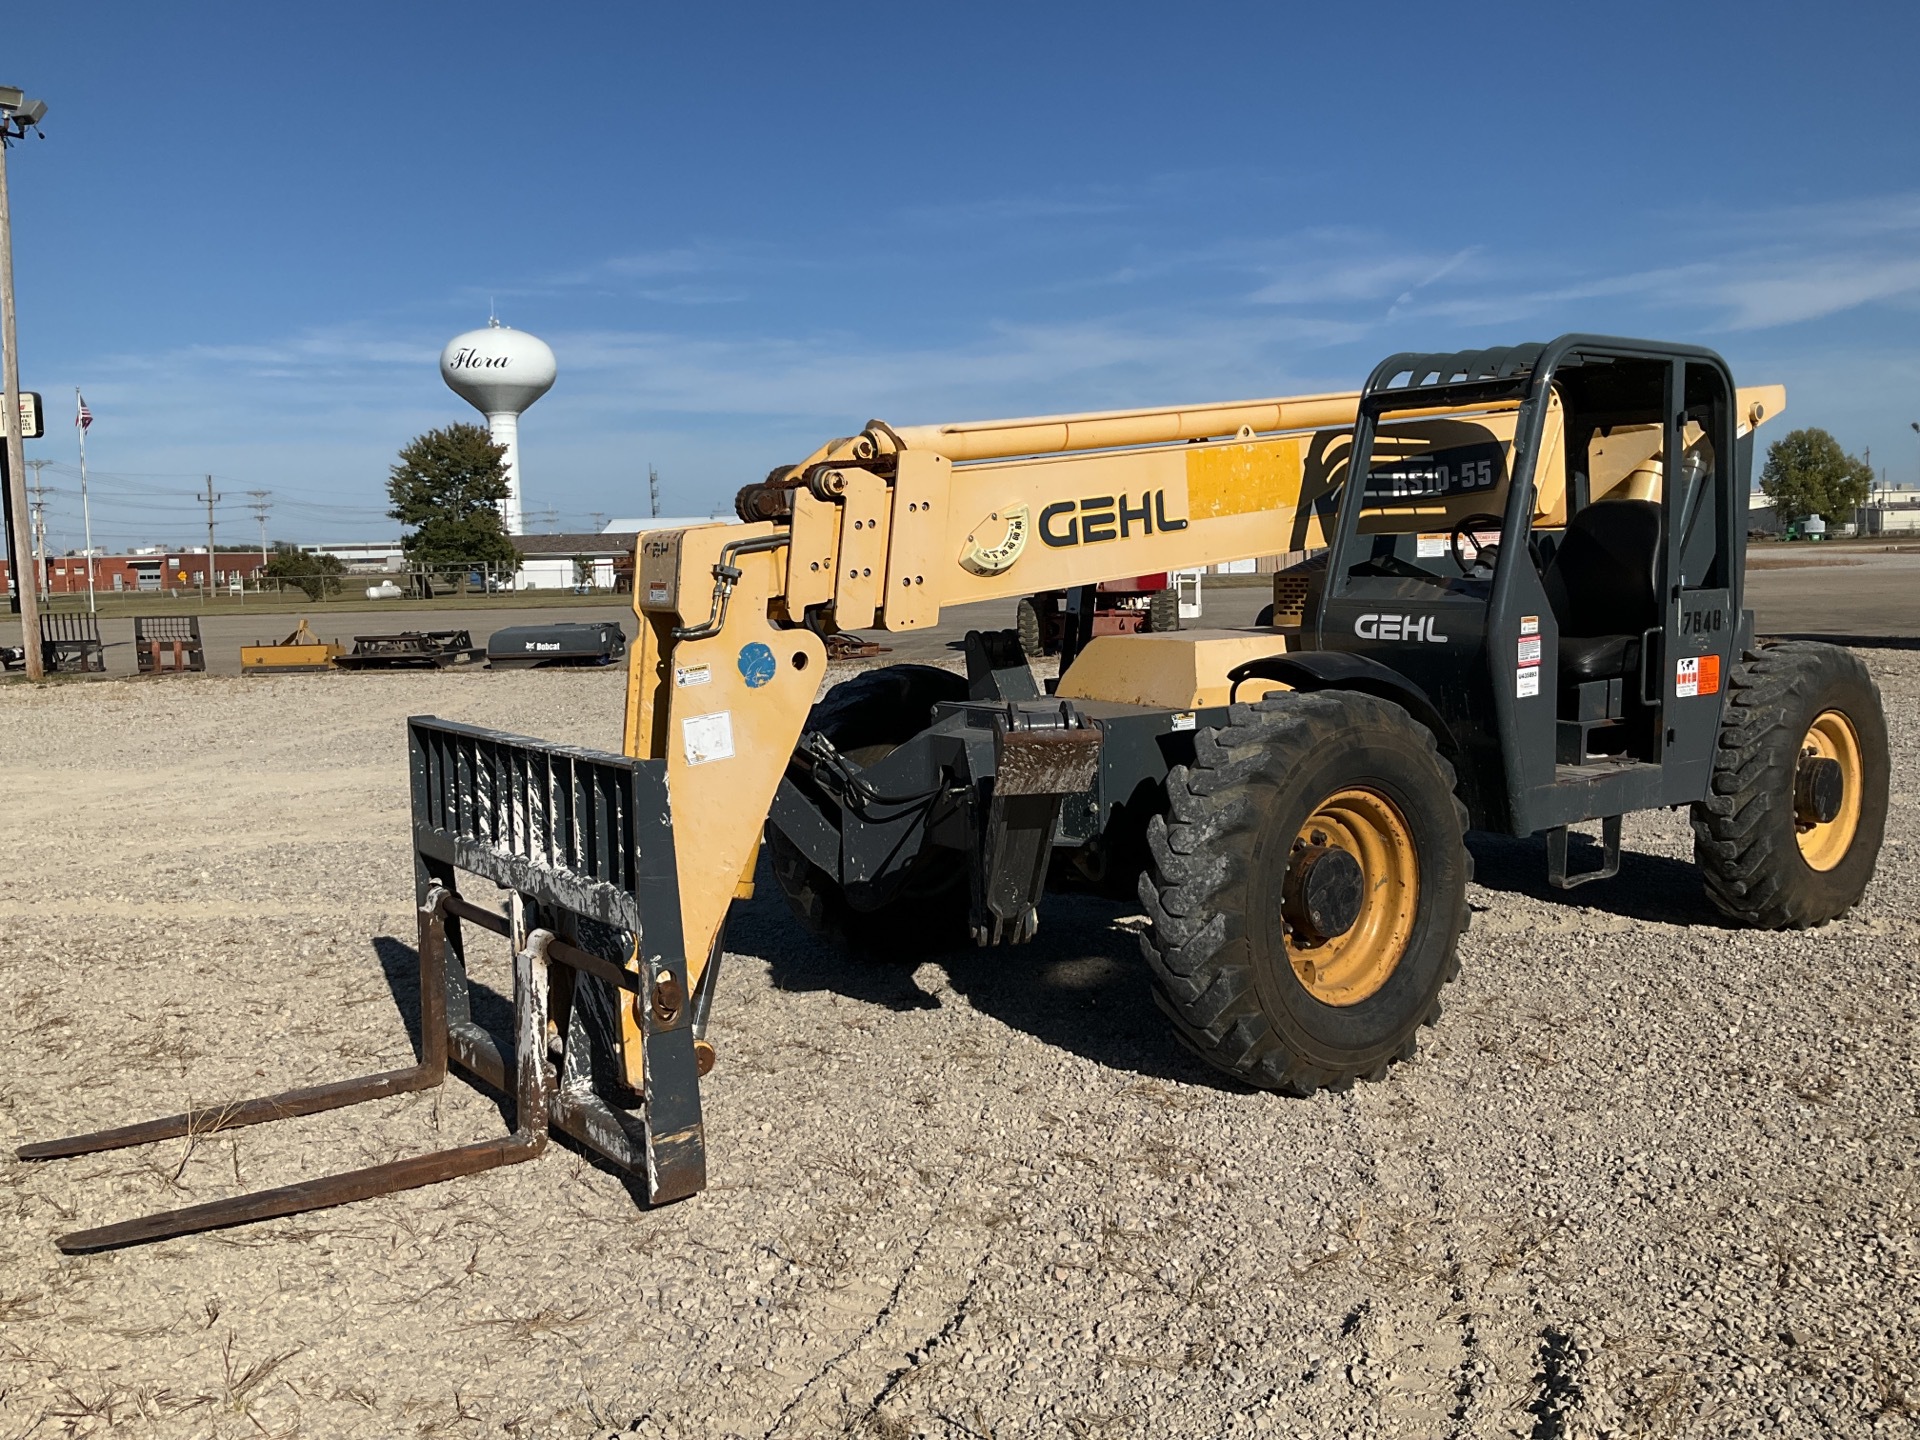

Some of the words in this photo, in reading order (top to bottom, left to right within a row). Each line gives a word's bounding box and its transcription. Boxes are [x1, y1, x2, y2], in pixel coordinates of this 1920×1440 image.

[450, 347, 513, 370] Flora
[1392, 460, 1491, 497] RS10-55
[1038, 489, 1188, 547] GEHL
[1354, 614, 1448, 643] GEHL
[536, 642, 560, 651] Bobcat
